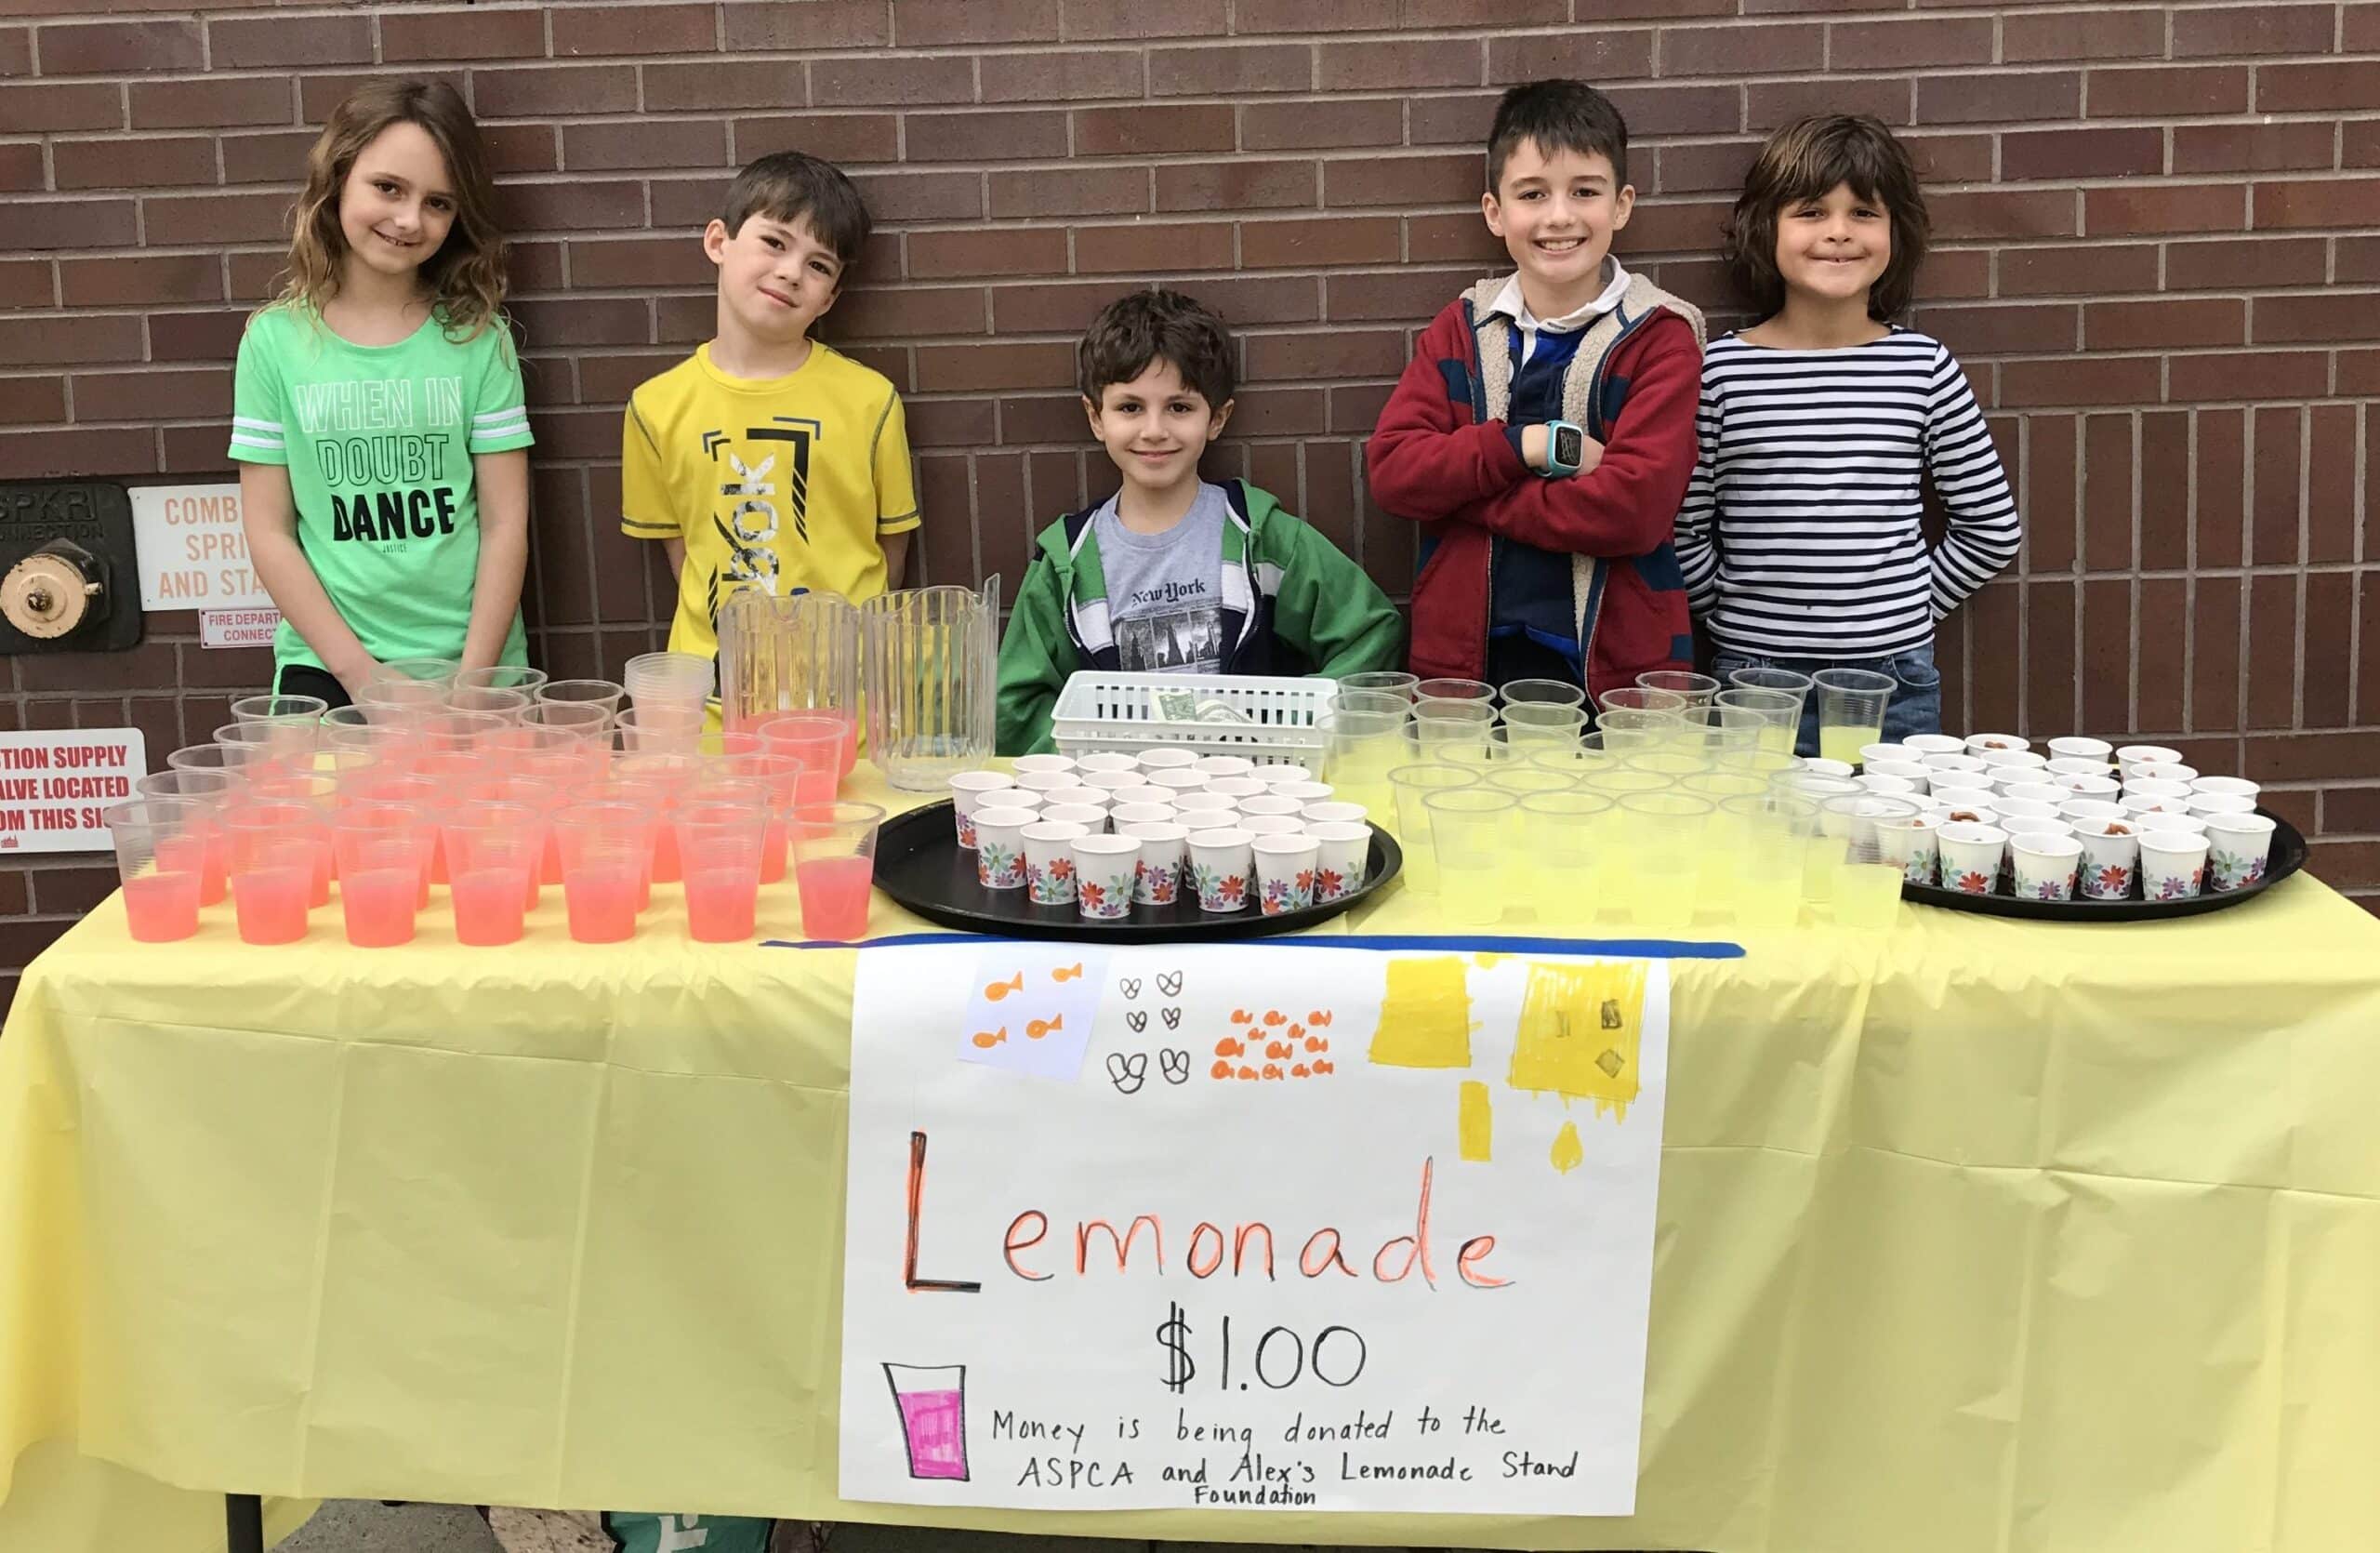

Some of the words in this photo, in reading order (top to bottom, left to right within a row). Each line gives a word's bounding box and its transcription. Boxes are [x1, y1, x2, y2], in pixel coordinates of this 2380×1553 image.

[294, 378, 414, 434] WHEN
[425, 376, 464, 427] IN
[316, 433, 450, 488] DOUBT
[165, 496, 239, 526] COMB
[330, 486, 456, 542] DANCE
[186, 533, 246, 562] SPRI
[159, 570, 209, 600] AND
[219, 568, 266, 597] STA
[1131, 588, 1163, 608] New
[1165, 578, 1207, 604] York
[209, 615, 233, 626] FIRE
[236, 613, 280, 625] DEPART
[223, 629, 278, 642] CONNEC
[0, 748, 48, 770] TION
[53, 745, 127, 768] SUPPLY
[43, 776, 129, 800] LOCATED
[29, 807, 77, 830] THIS
[903, 1128, 1516, 1294] Lemonade
[1156, 1301, 1367, 1394] $1.00
[992, 1410, 1085, 1453] Money
[1118, 1415, 1140, 1440] is
[1176, 1406, 1253, 1453] being
[1284, 1409, 1394, 1443] donated
[1417, 1405, 1441, 1435] to
[1462, 1405, 1506, 1435] the
[1017, 1456, 1134, 1489] ASPCA
[1161, 1457, 1208, 1484] and
[1229, 1452, 1316, 1483] Alex's
[1342, 1451, 1474, 1481] Lemonade
[1501, 1450, 1579, 1479] Stand
[1195, 1484, 1316, 1506] Foundation
